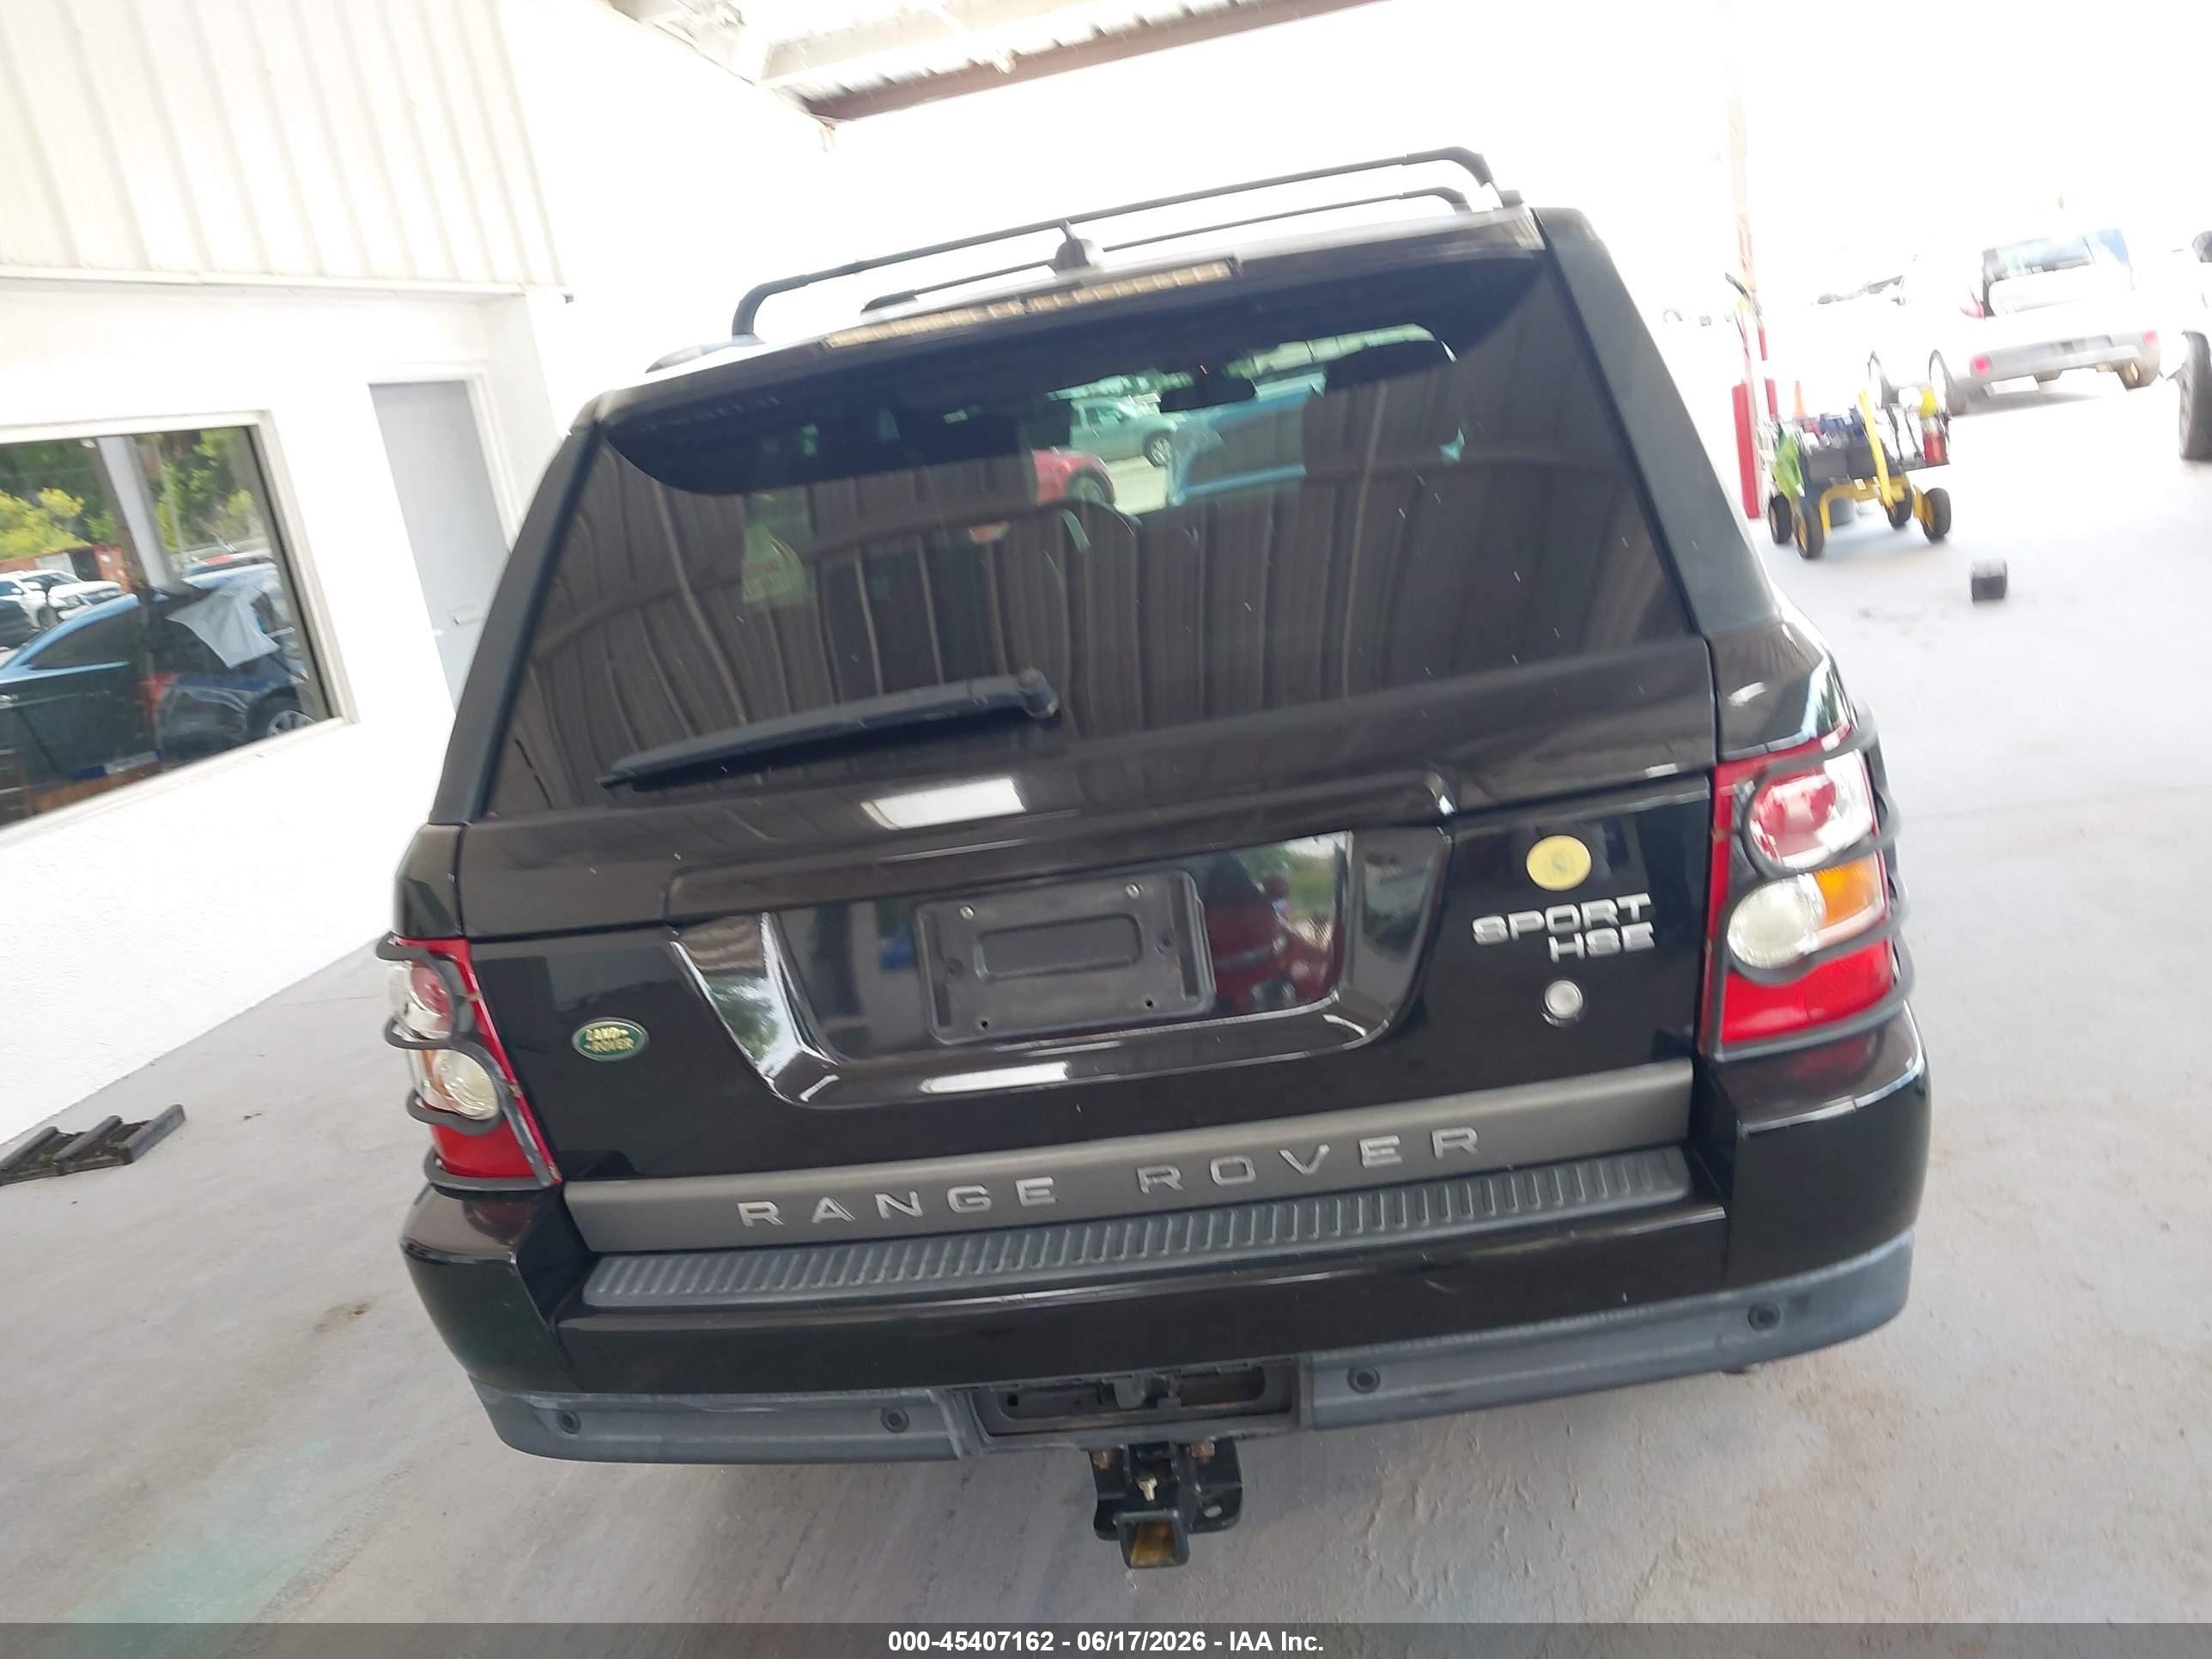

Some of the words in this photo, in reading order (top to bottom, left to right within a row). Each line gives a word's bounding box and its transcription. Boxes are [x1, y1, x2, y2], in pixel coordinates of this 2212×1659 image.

[1472, 892, 1651, 945] SPORT
[1547, 921, 1655, 963] HSE
[737, 1176, 1057, 1227] RANGE
[1135, 1125, 1480, 1194] ROVER
